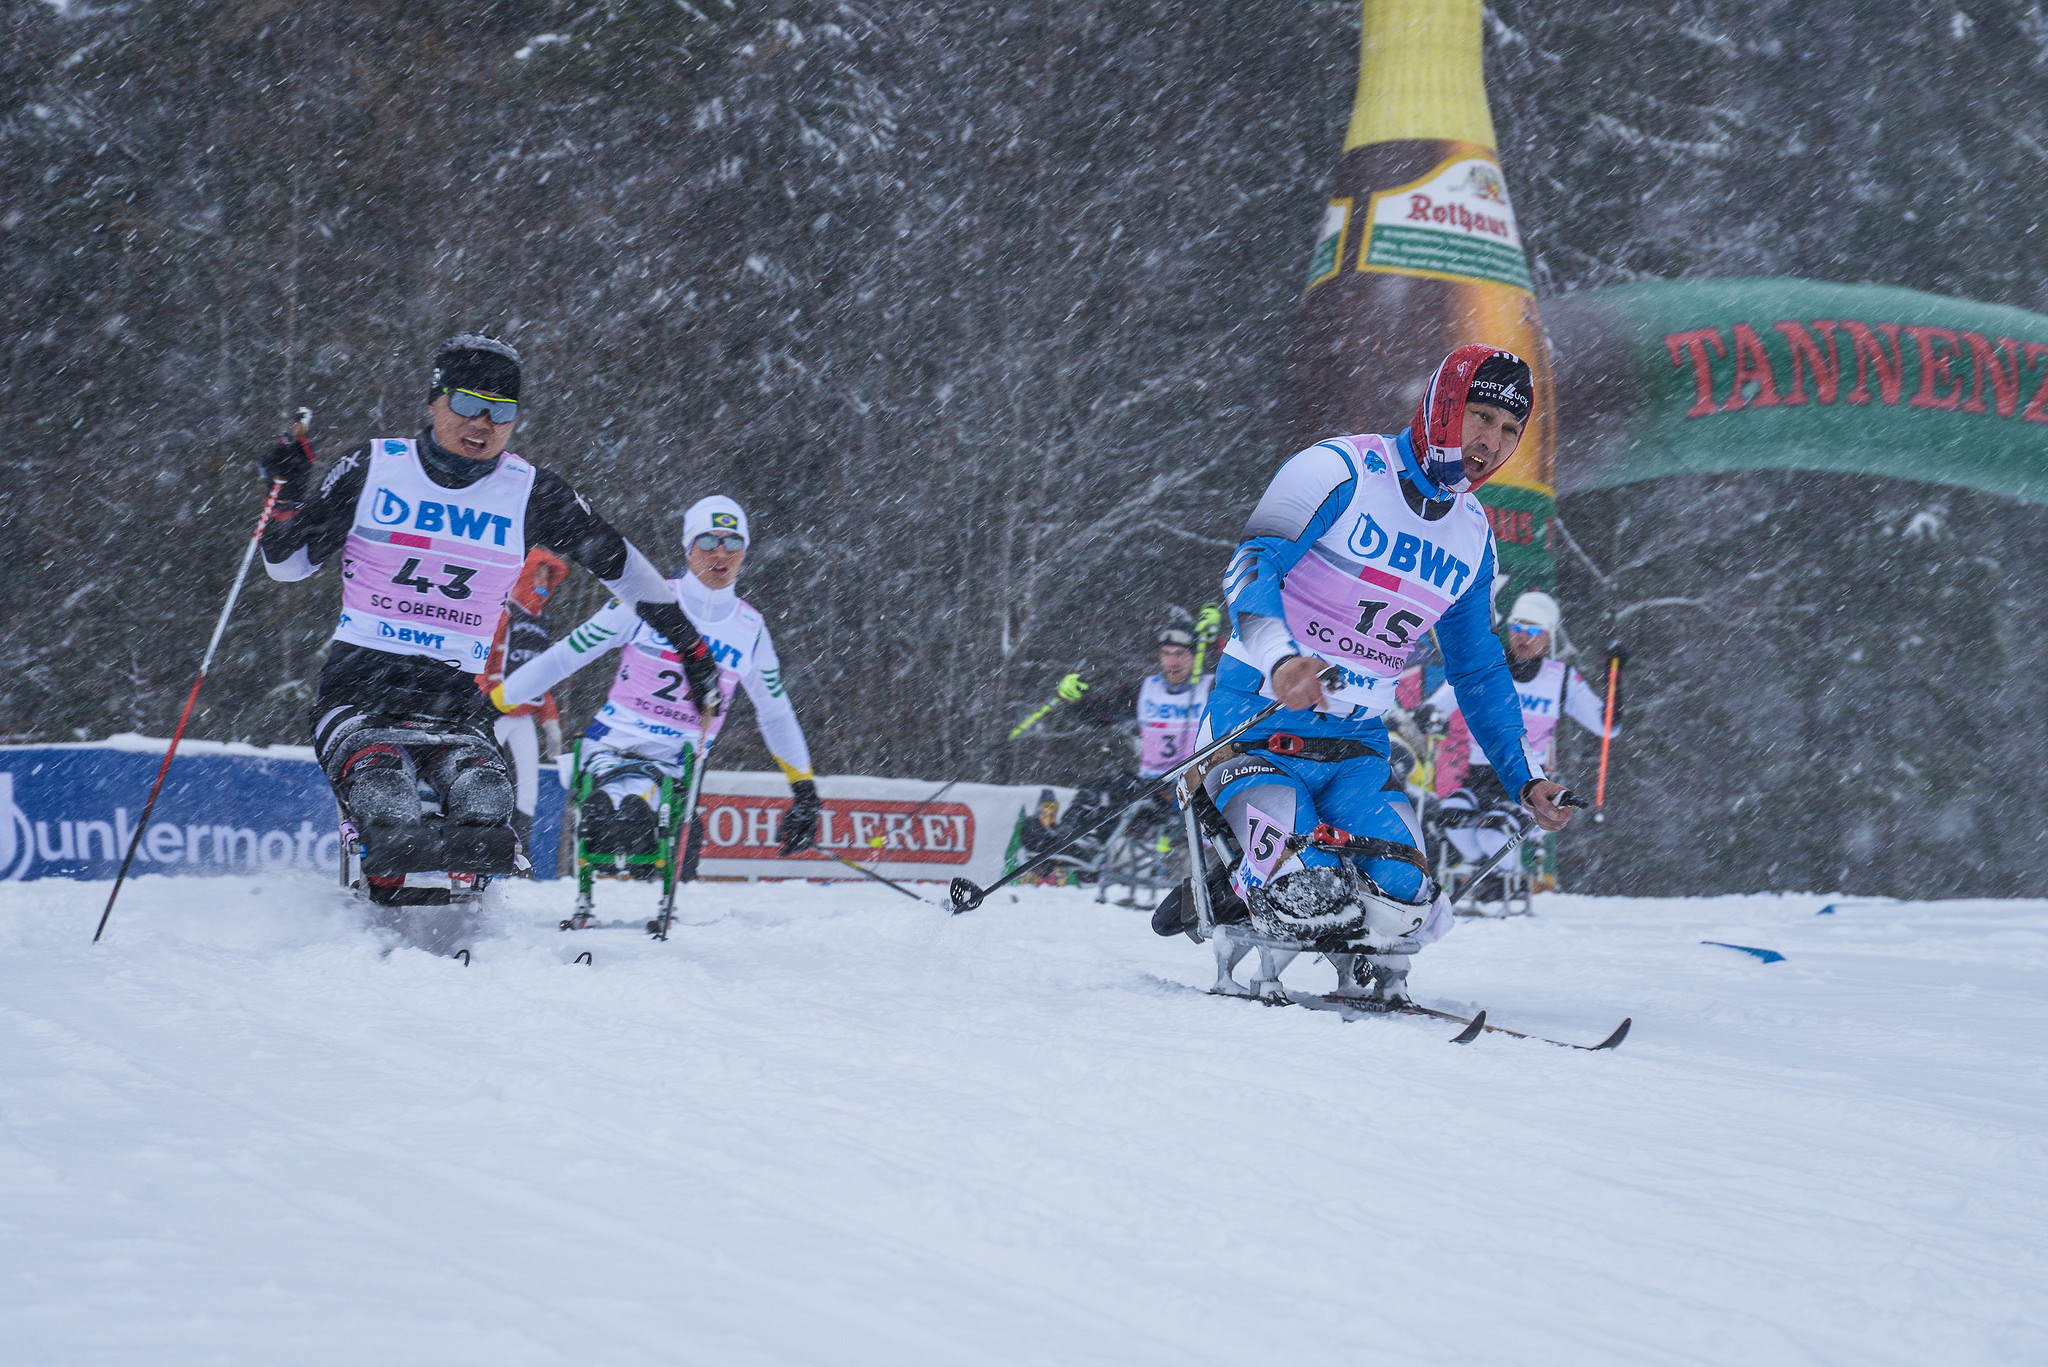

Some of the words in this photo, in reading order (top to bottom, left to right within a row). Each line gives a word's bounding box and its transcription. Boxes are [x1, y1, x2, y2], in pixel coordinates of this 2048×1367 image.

[1405, 194, 1509, 238] Rothaus
[414, 500, 513, 547] BWT
[391, 557, 479, 600] 43
[1387, 531, 1472, 597] BWT
[371, 594, 393, 610] SC
[397, 600, 483, 627] OBERRIED
[1354, 599, 1425, 649] 15
[397, 628, 445, 650] BWT
[1305, 620, 1335, 644] SC
[702, 633, 743, 669] WT
[651, 669, 695, 702] 2
[1519, 693, 1553, 715] WT
[1160, 734, 1177, 759] 3
[1248, 817, 1285, 862] 15
